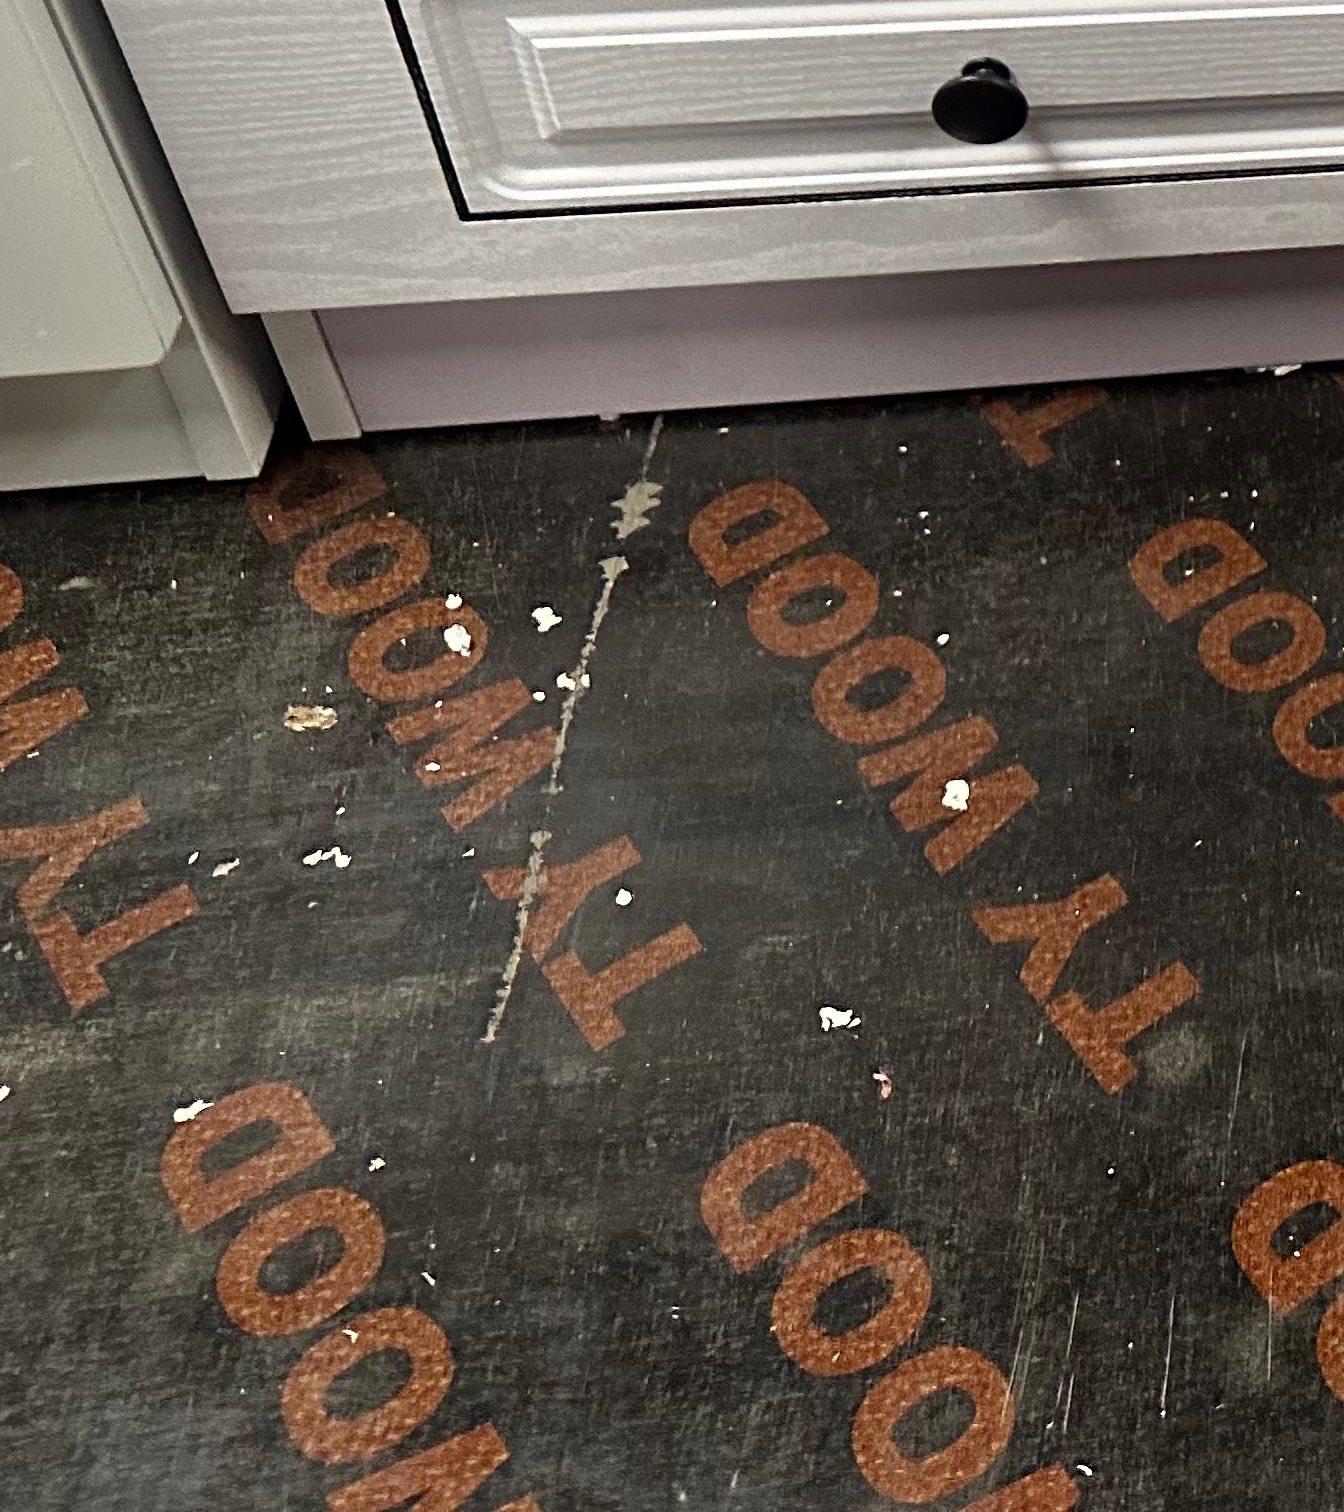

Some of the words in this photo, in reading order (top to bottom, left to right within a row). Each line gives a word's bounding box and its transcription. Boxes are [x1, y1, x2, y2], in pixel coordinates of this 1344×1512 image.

[245, 445, 559, 832] WOOD
[688, 481, 1039, 877] WOOD
[0, 794, 199, 1010] TY
[482, 836, 704, 1050] TY
[972, 873, 1200, 1094] TY
[700, 1121, 1079, 1512] OOD
